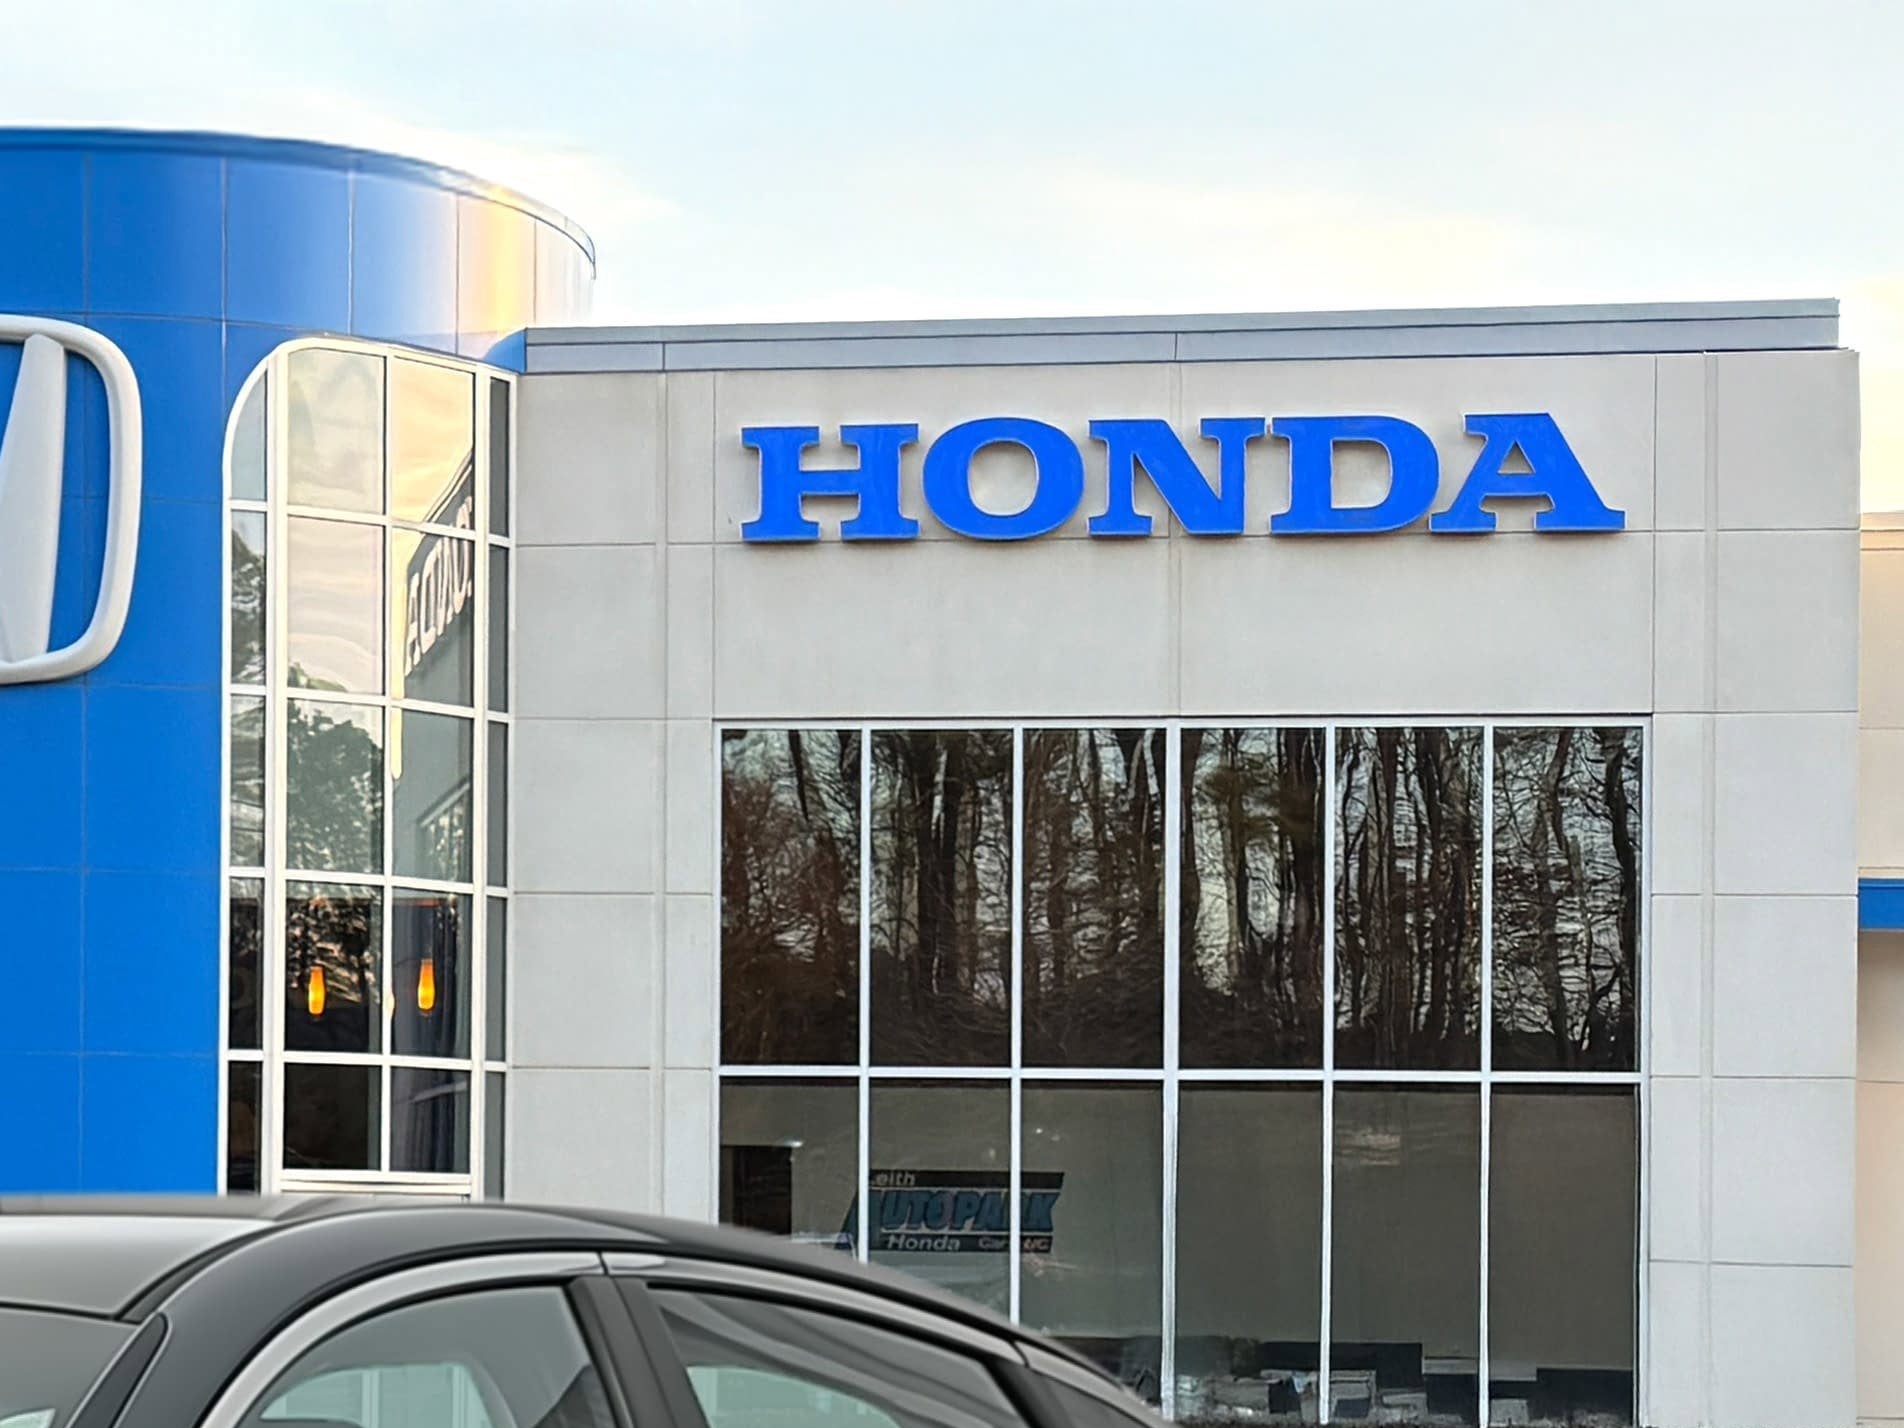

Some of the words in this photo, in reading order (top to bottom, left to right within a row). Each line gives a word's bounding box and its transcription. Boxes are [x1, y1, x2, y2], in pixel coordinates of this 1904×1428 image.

[740, 412, 1627, 542] HONDA
[870, 1172, 916, 1186] eith
[887, 1235, 961, 1250] Honda
